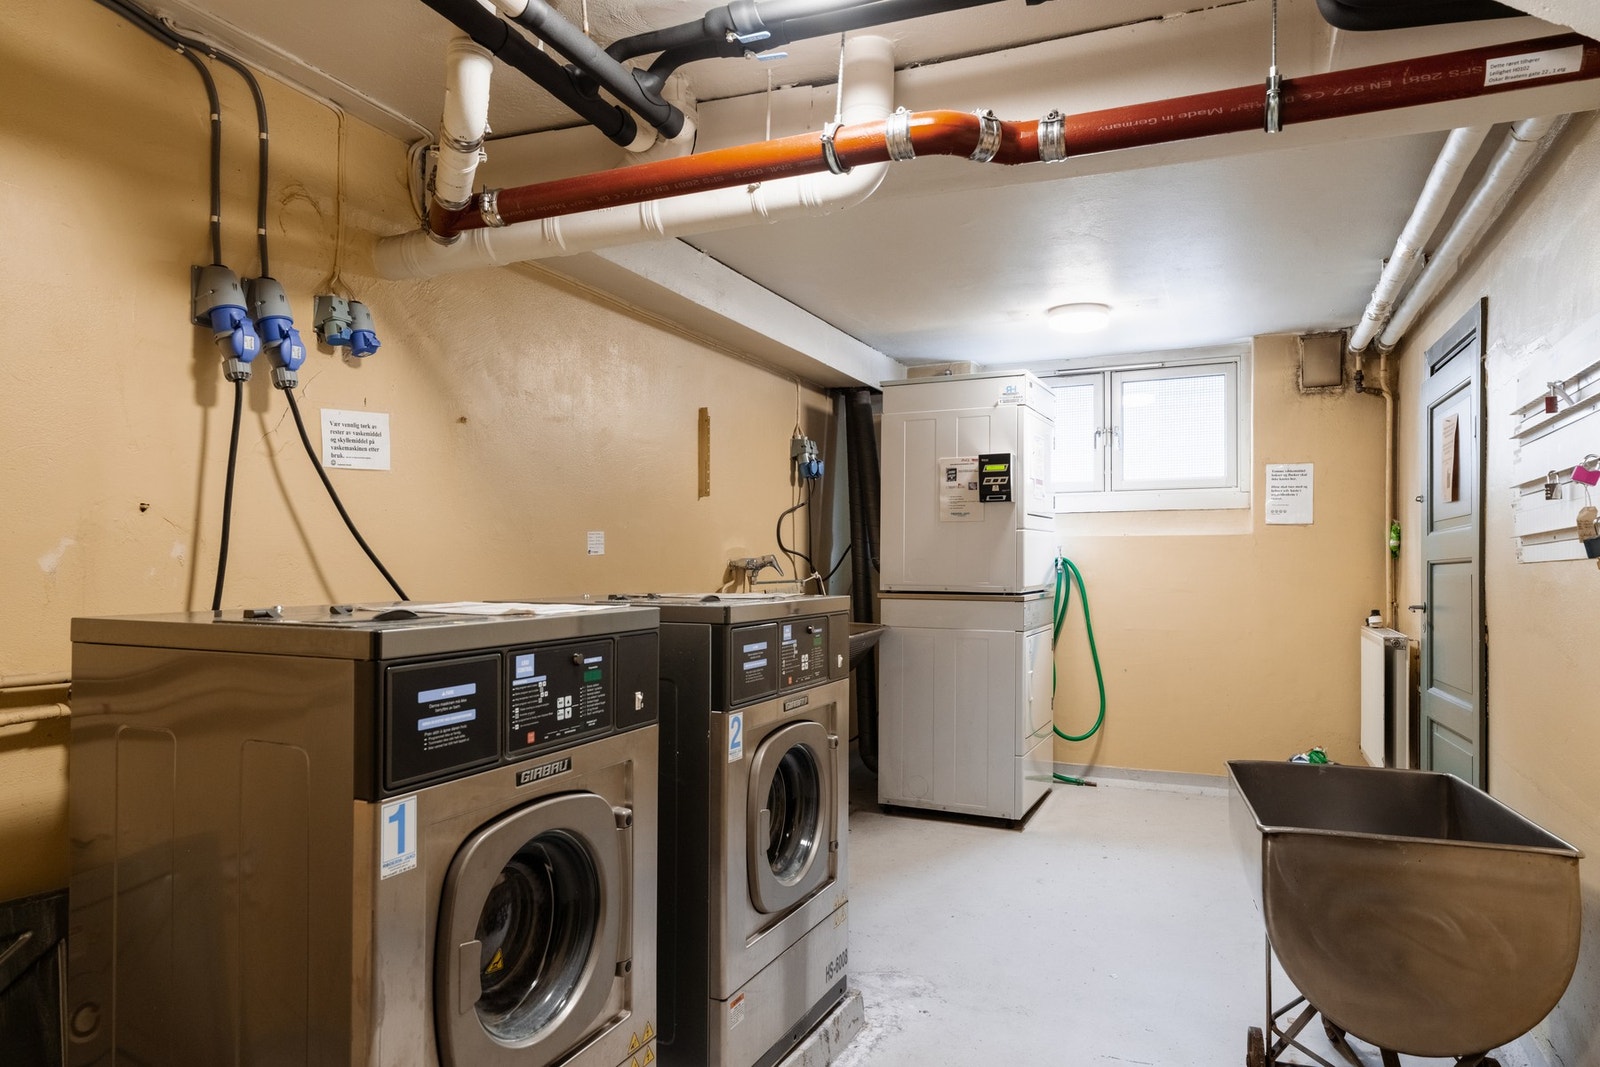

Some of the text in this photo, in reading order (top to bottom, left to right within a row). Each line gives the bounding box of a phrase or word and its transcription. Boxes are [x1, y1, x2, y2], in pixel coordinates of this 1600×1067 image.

[1520, 57, 1541, 65] tilhører
[1449, 65, 1483, 77] SFS
[1489, 68, 1512, 76] Leilighet
[1332, 84, 1365, 96] 877
[1369, 79, 1392, 89] EN
[1161, 114, 1175, 122] in
[1178, 106, 1224, 119] Made
[1097, 117, 1158, 132] Germany
[341, 422, 360, 430] vennlig
[730, 716, 741, 750] 2
[520, 759, 569, 784] GIRBAU
[388, 803, 406, 855] 1
